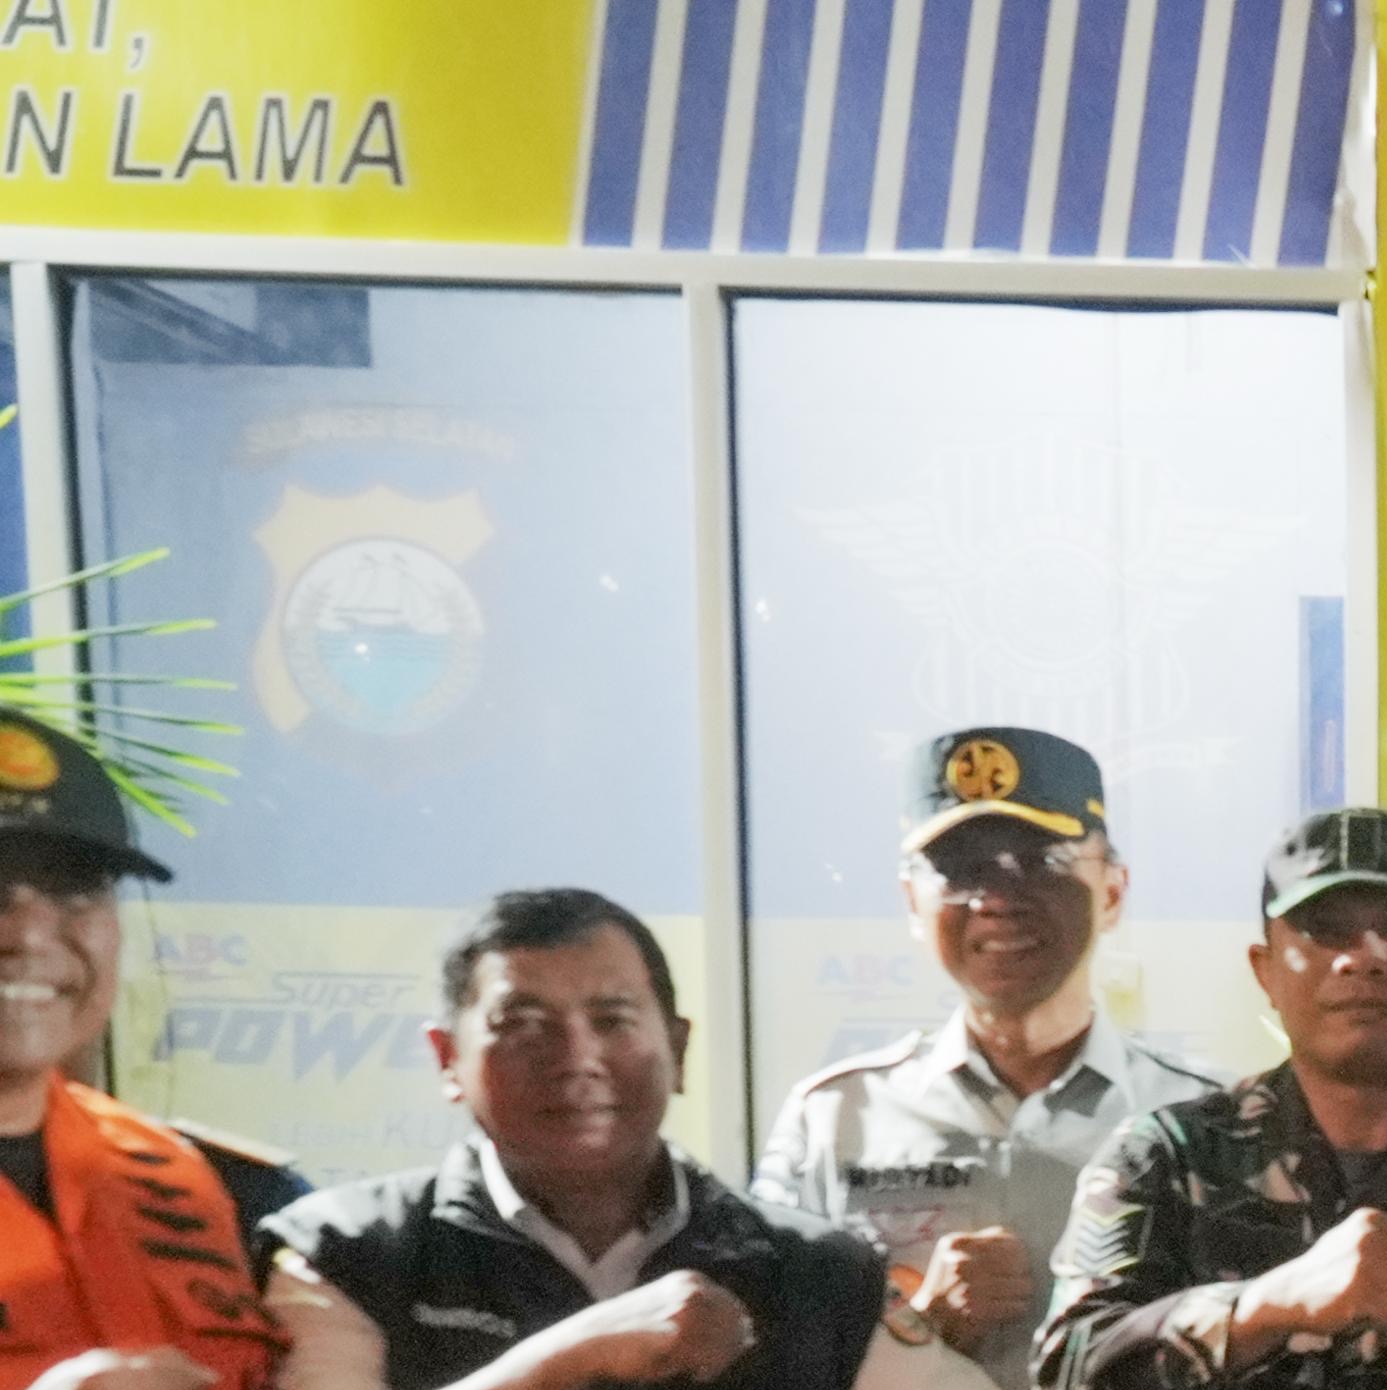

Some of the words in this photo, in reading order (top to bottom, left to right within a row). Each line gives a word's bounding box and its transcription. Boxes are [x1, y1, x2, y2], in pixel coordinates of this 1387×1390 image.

[6, 91, 72, 174] N
[113, 94, 404, 186] LAMA
[272, 971, 421, 1012] Super
[151, 1009, 440, 1085] POWE
